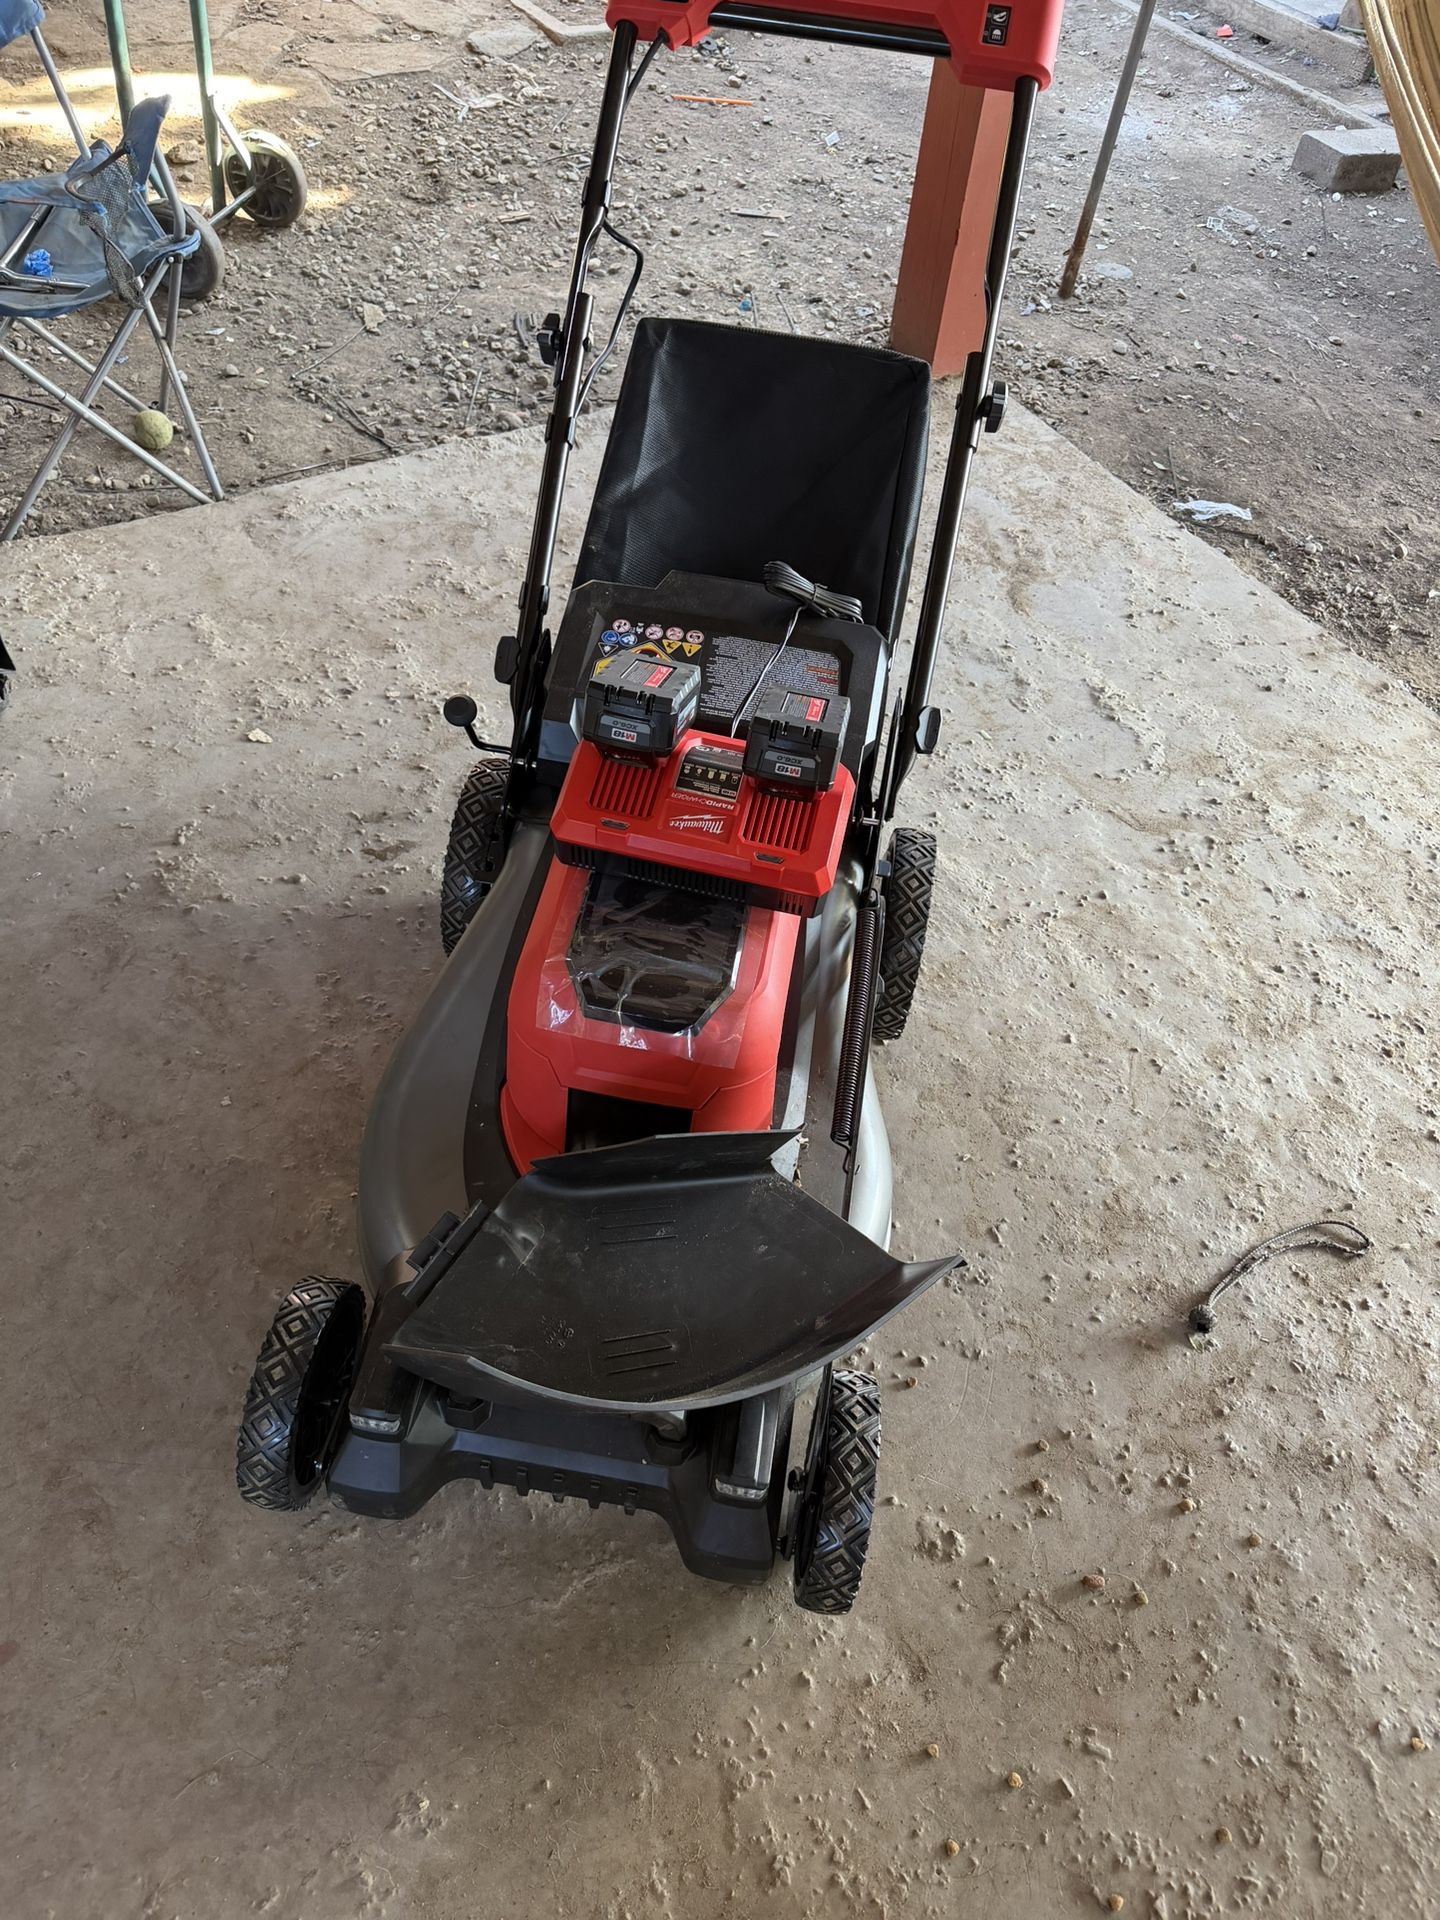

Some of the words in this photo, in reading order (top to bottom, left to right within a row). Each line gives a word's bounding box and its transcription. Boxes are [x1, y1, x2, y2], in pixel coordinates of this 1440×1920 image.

[613, 730, 636, 741] M18
[776, 765, 800, 777] M18
[669, 820, 725, 834] Milwaukee
